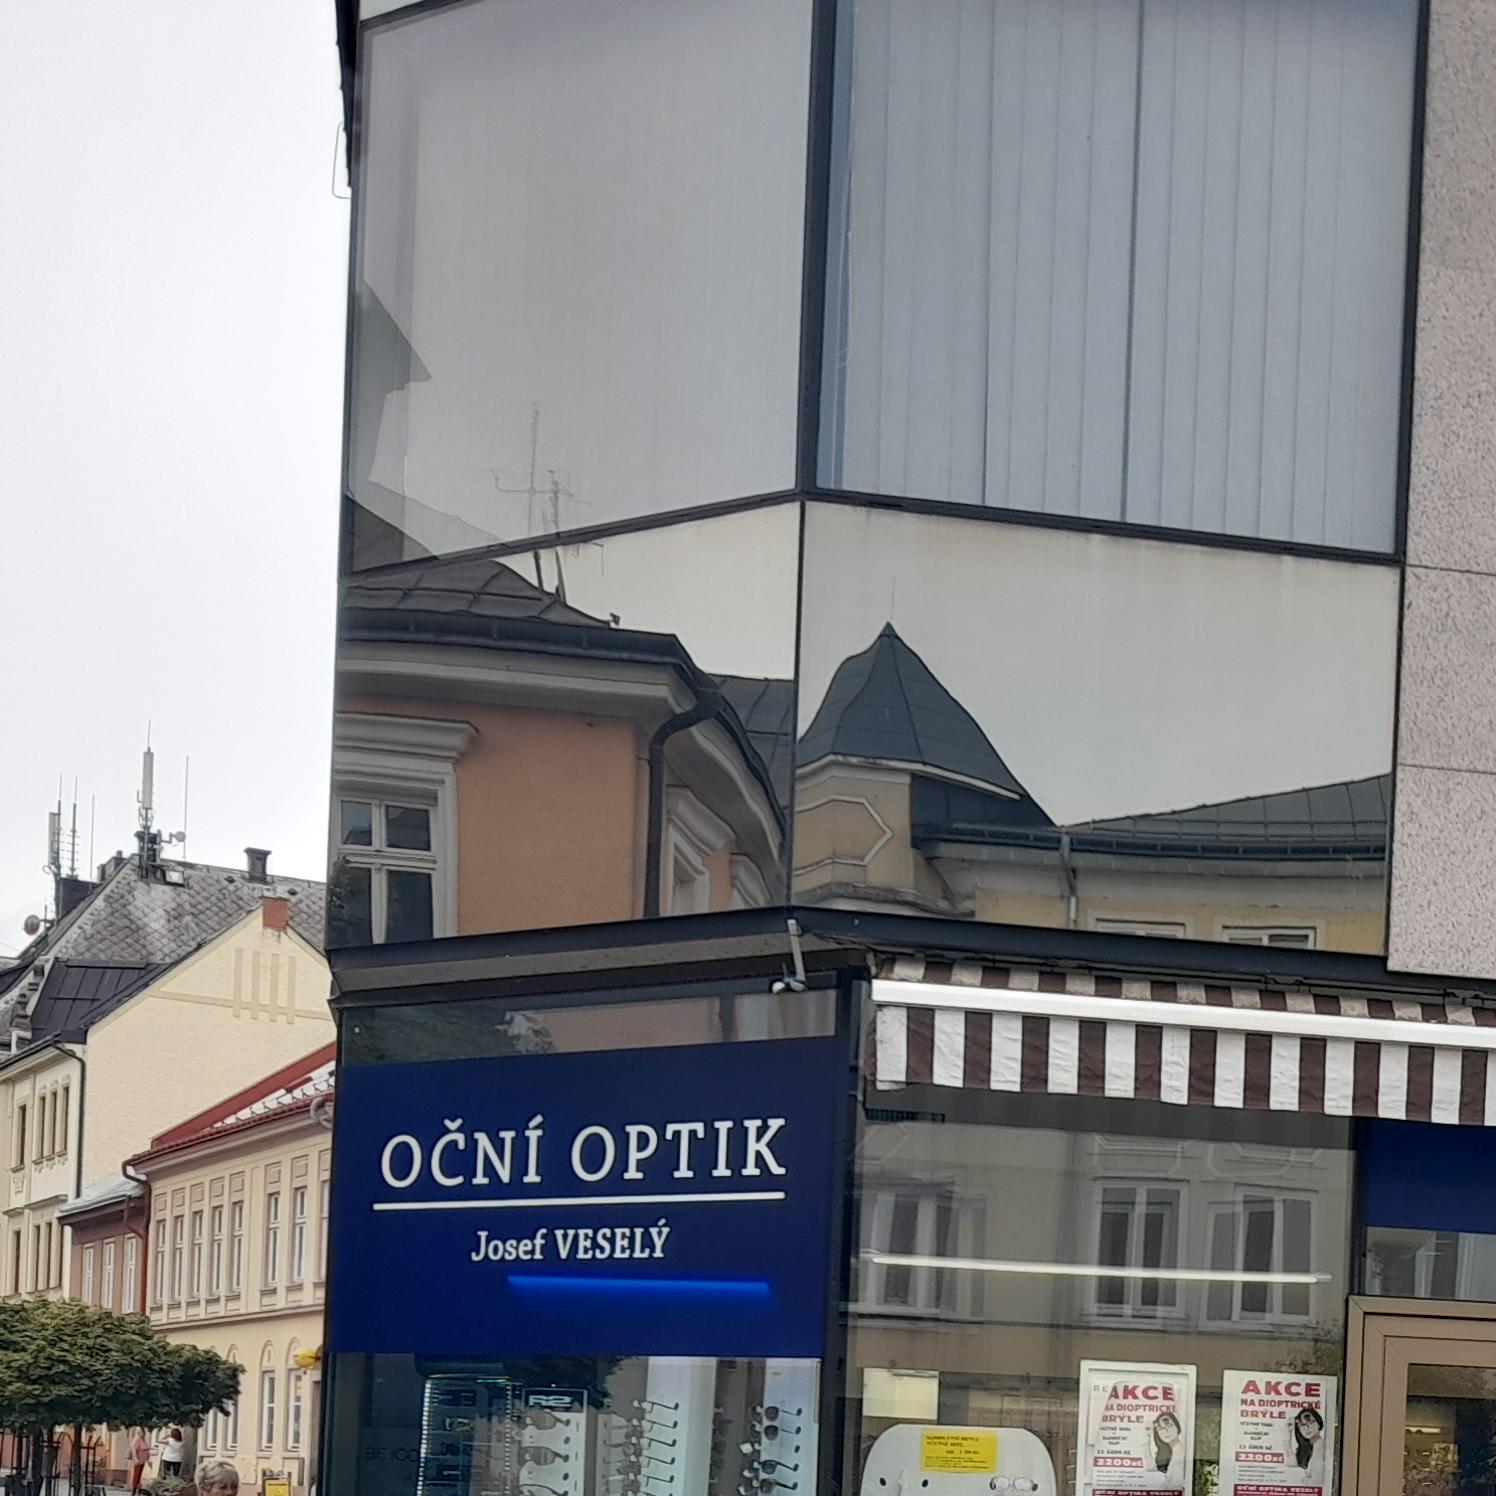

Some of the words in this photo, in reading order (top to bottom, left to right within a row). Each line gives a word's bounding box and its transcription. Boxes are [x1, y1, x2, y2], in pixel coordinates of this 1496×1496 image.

[380, 1114, 545, 1188] OČNÍ
[570, 1118, 788, 1182] OPTIK
[471, 1227, 547, 1262] Josef
[554, 1218, 670, 1260] VESELÝ
[1108, 1385, 1175, 1401] AKCE
[1241, 1380, 1321, 1397] AKCE
[1240, 1399, 1256, 1407] NA
[1258, 1399, 1322, 1410] DIOPTRICKÉ
[1240, 1409, 1287, 1419] BRÝLE
